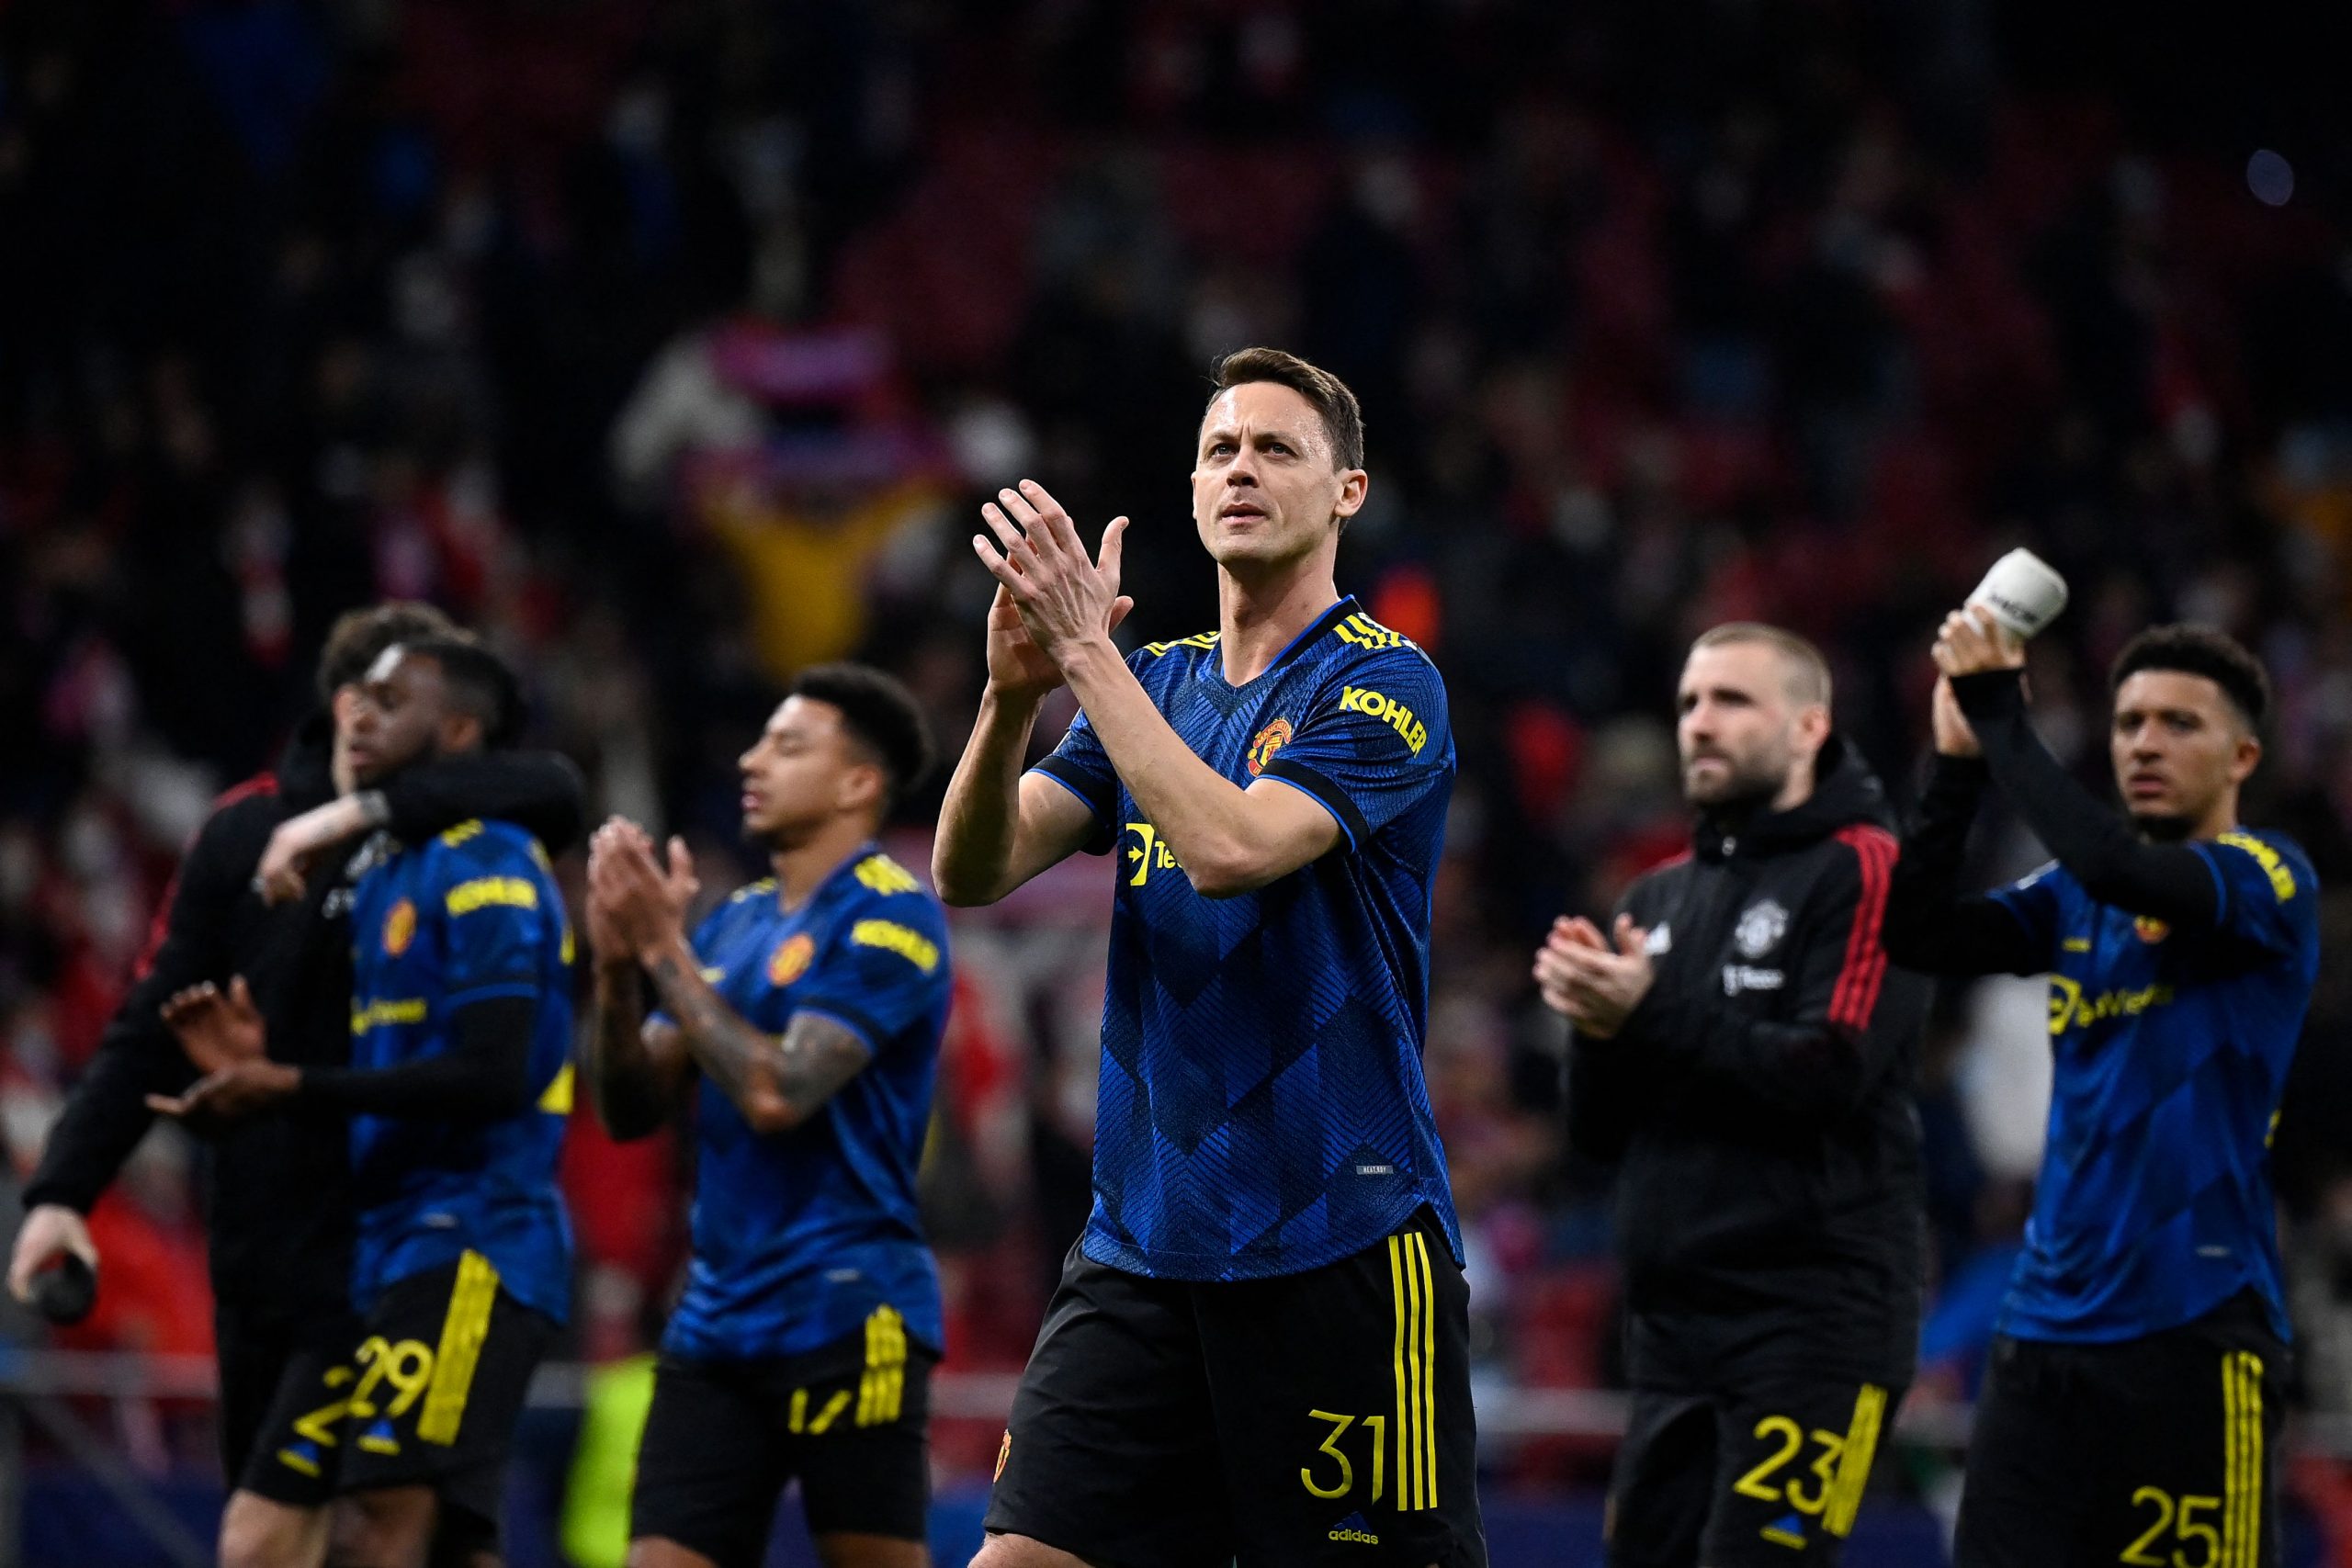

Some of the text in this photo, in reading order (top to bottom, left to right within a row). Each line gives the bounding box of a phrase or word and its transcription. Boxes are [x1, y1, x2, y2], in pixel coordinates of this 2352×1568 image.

[1339, 685, 1427, 759] KOHLER
[355, 1336, 435, 1418] 29
[1301, 1409, 1385, 1506] 31
[1733, 1415, 1845, 1514] 23
[1328, 1529, 1379, 1545] adidas
[2120, 1484, 2221, 1568] 25
